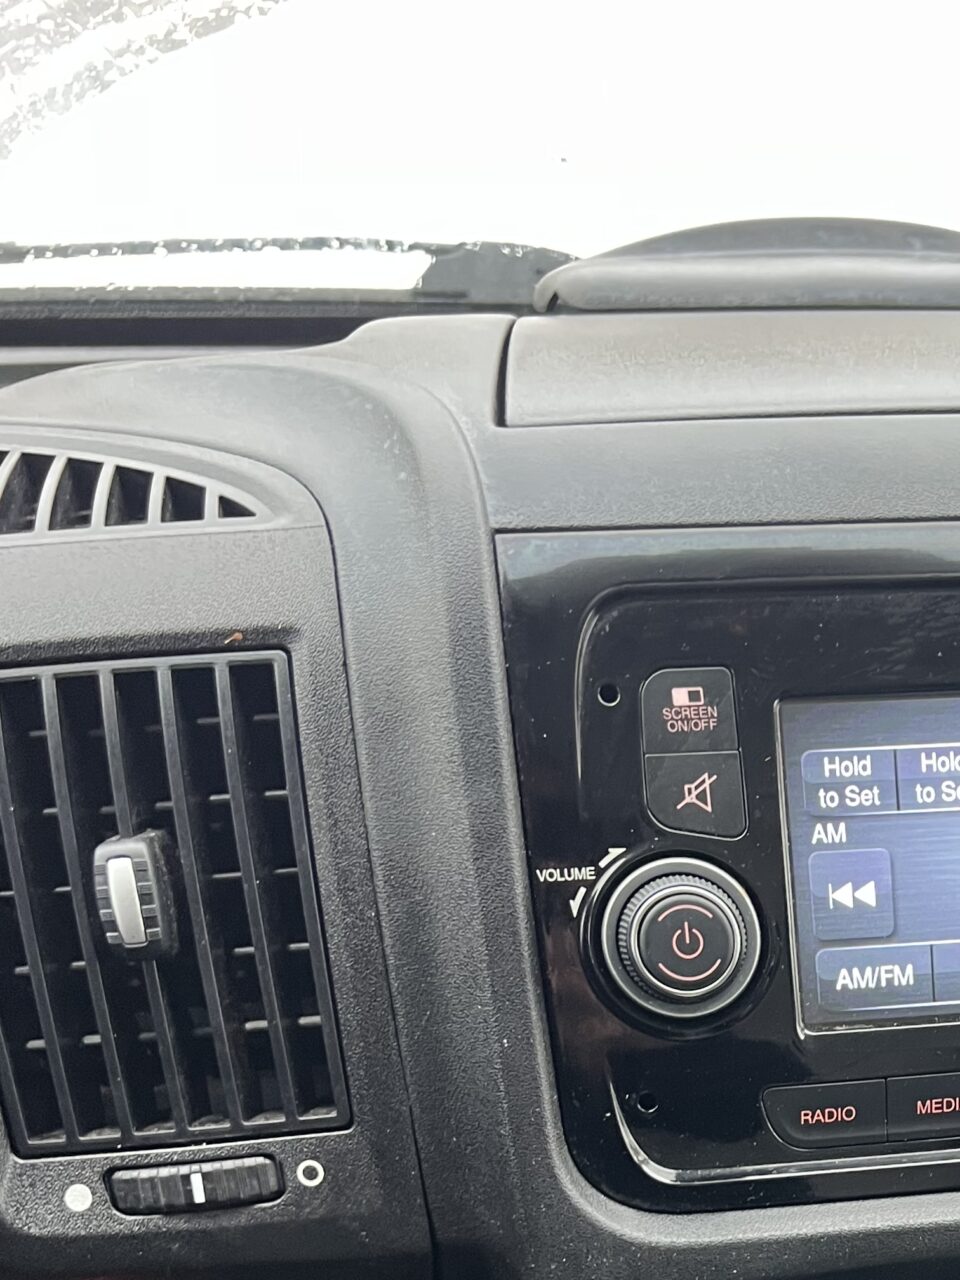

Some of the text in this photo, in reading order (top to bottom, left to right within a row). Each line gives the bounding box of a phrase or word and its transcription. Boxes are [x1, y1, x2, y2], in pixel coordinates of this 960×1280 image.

[662, 706, 718, 720] SCREEN
[667, 718, 718, 732] ON/OFF
[823, 755, 872, 778] Hold
[818, 786, 881, 808] to Set
[915, 784, 936, 803] to
[811, 823, 847, 845] AM
[536, 866, 597, 882] VOLUME
[835, 964, 914, 991] AM/FM
[800, 1106, 857, 1125] RADIO
